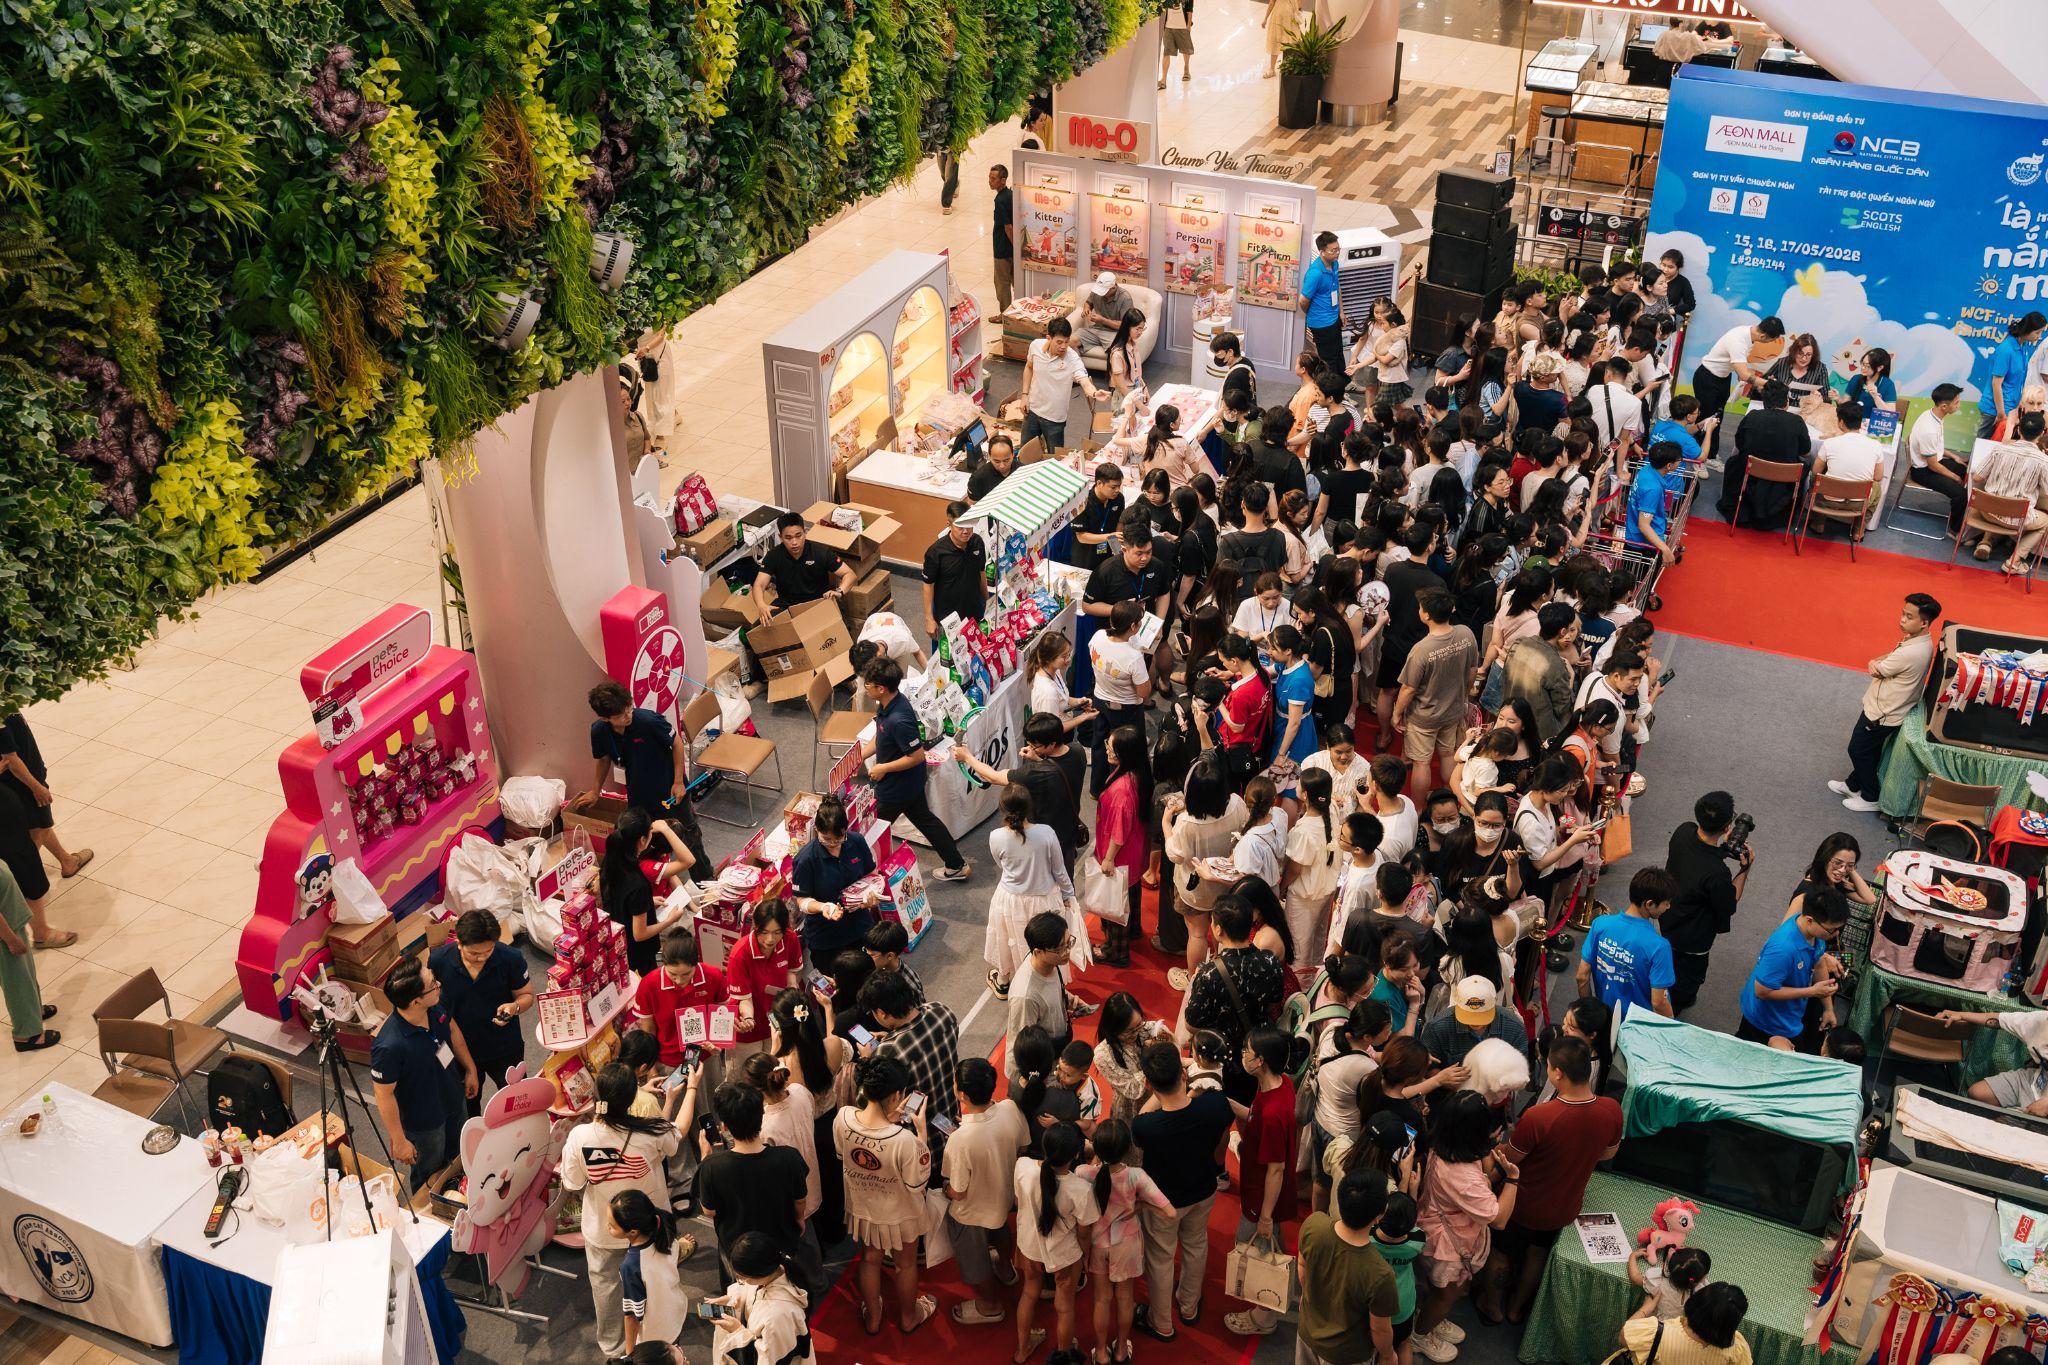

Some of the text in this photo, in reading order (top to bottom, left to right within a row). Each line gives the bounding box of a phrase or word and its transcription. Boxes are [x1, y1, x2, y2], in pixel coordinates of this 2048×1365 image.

[1069, 116, 1138, 152] Me-O
[1757, 129, 1797, 144] MALL
[1860, 136, 1921, 157] NCB
[1206, 150, 1239, 171] Yêu
[1811, 156, 1841, 167] NGÂN
[1842, 159, 1872, 171] HÀNG
[1906, 167, 1930, 177] DÂN
[2014, 161, 2036, 171] WCF
[1034, 193, 1062, 206] Me-O
[1105, 202, 1133, 216] Me-O
[1034, 211, 1064, 224] Kitten
[1180, 212, 1209, 227] Me-O
[1862, 210, 1903, 224] SCOTS
[1103, 224, 1134, 236] Indoor
[1254, 223, 1284, 238] Me-O
[1860, 220, 1901, 232] ENGLISH
[1120, 235, 1139, 245] Cat
[1176, 231, 1212, 245] Persian
[1734, 233, 1754, 249] 15,
[1780, 239, 1861, 262] 17/05/2026
[1960, 306, 1996, 322] WCF
[373, 648, 409, 679] choice
[559, 855, 593, 887] choice
[843, 1168, 899, 1184] Handmade
[57, 1270, 75, 1285] VCA
